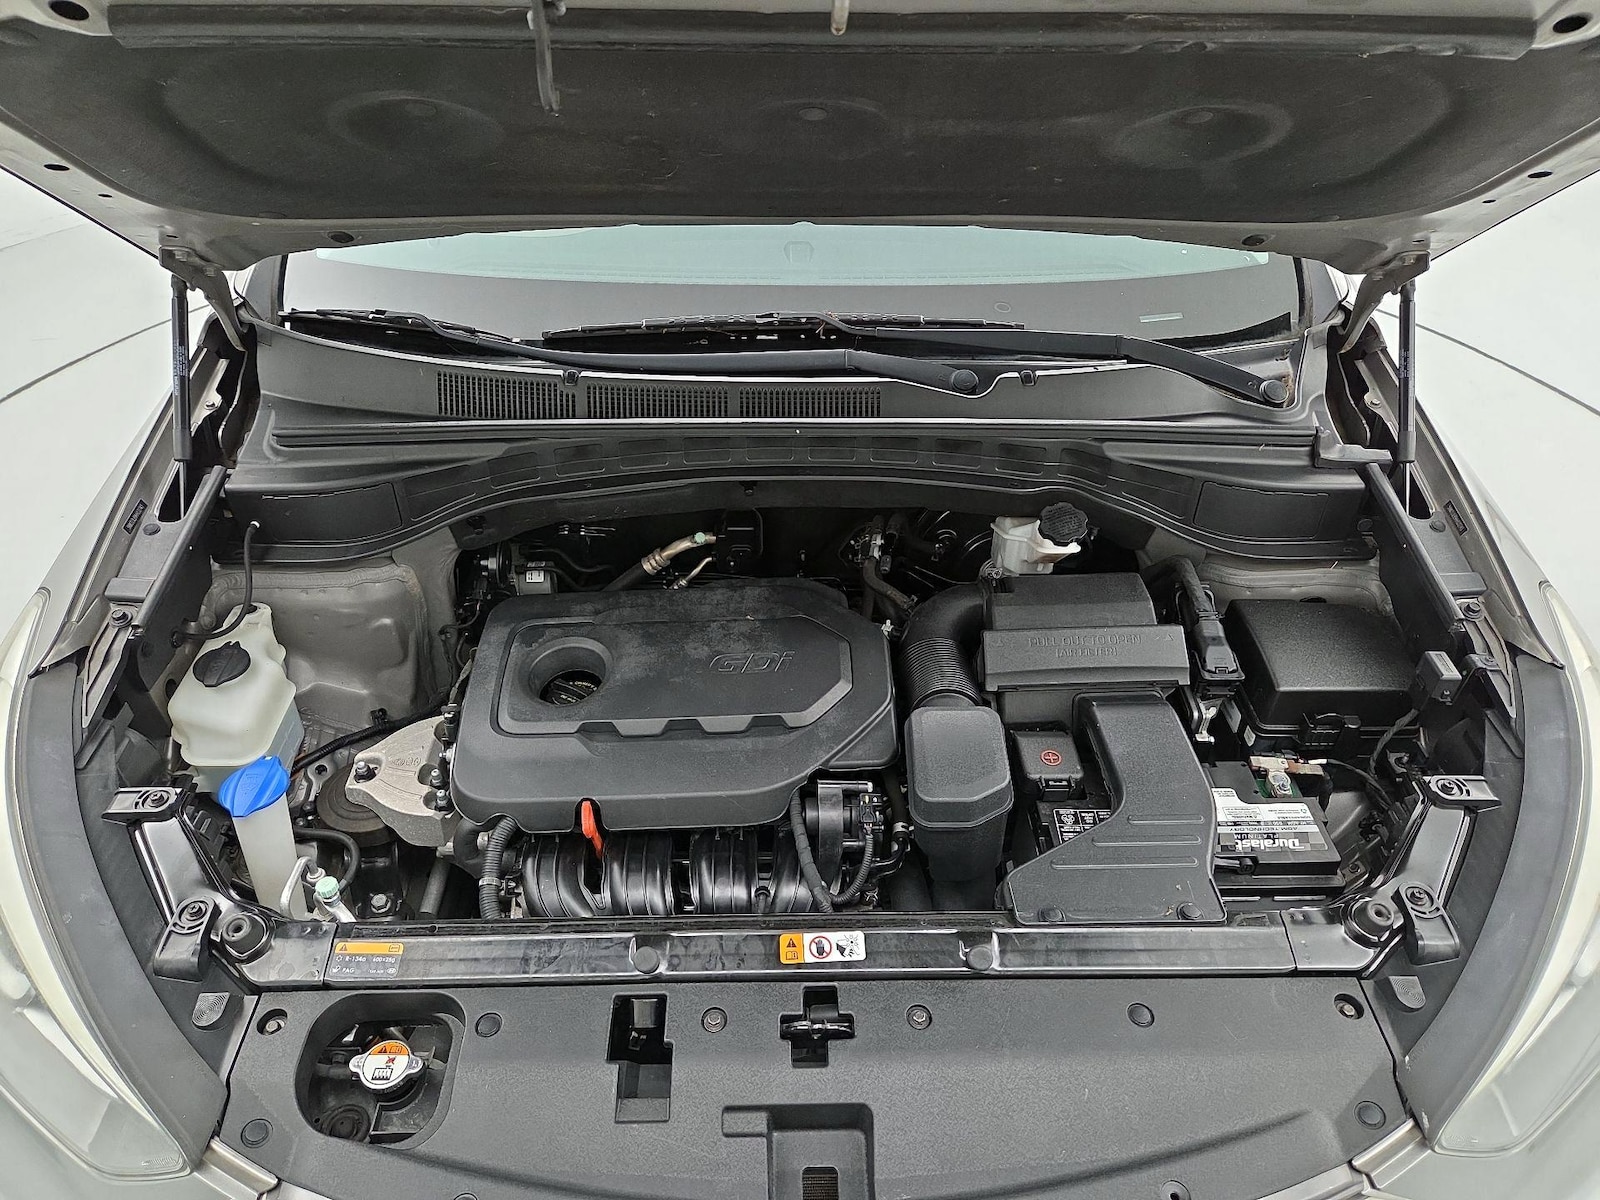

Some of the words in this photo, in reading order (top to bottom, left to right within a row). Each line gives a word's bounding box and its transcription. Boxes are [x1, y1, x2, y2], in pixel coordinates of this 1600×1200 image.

[1028, 636, 1058, 647] PULL
[1062, 635, 1086, 646] OUT
[1090, 634, 1106, 645] TO
[1108, 633, 1142, 645] OPEN
[1233, 832, 1279, 840] PLATINUM
[1235, 839, 1305, 851] Duralast
